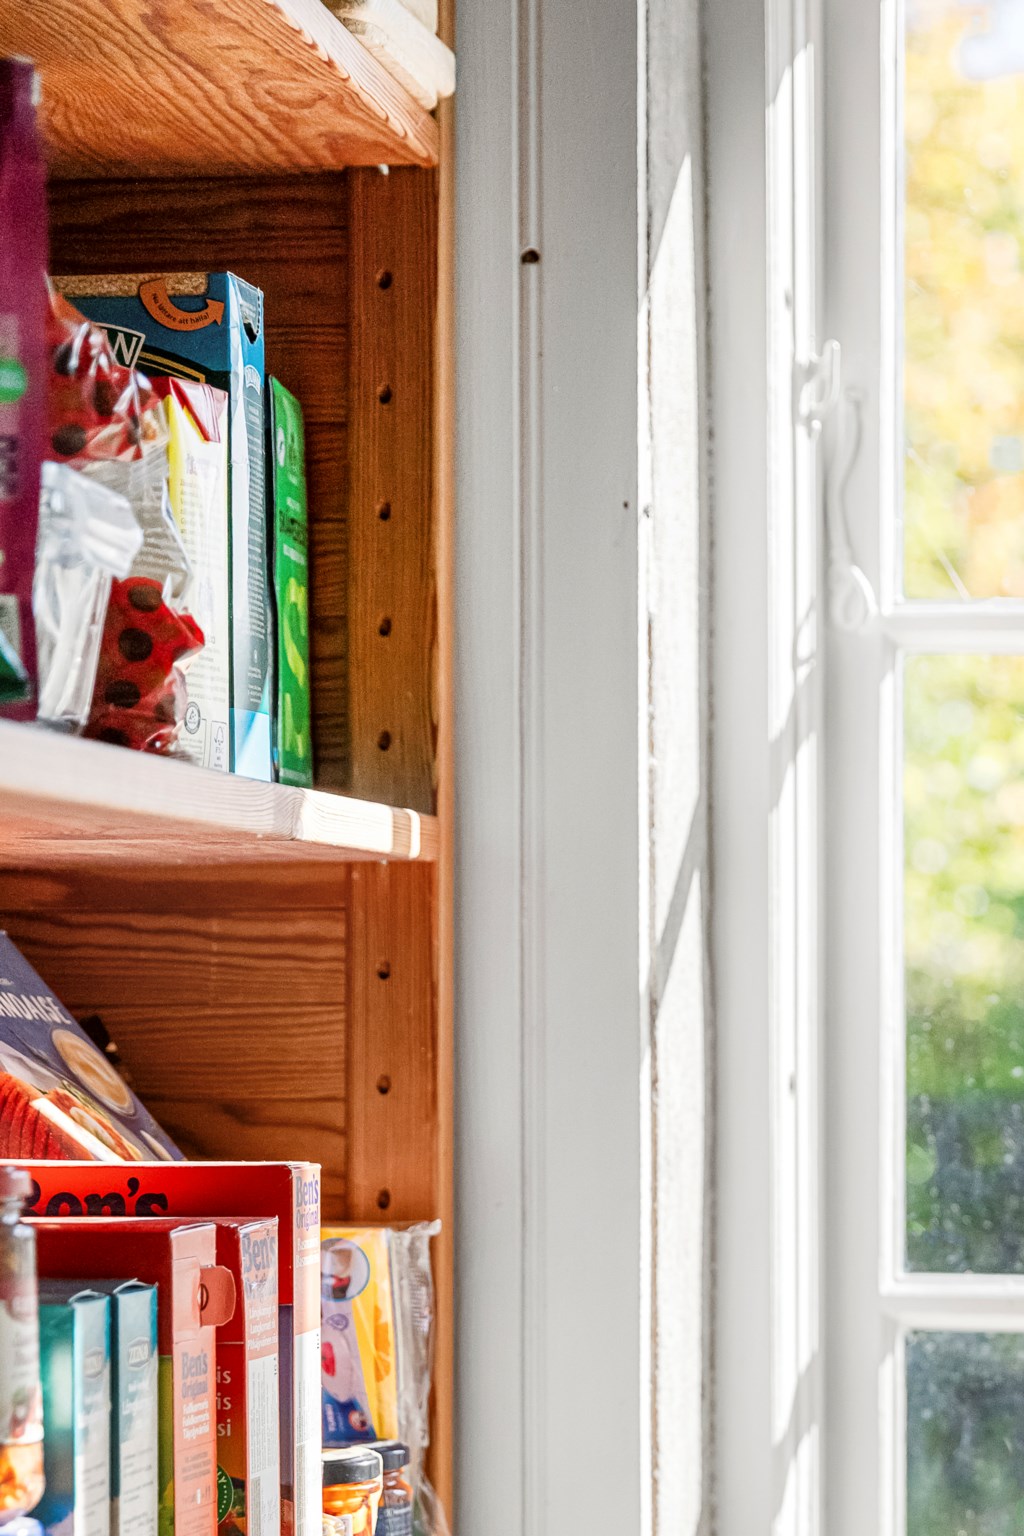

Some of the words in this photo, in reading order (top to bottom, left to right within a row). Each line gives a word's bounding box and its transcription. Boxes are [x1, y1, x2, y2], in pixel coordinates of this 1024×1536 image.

[178, 316, 189, 325] att
[295, 1173, 319, 1208] Ben's
[182, 1348, 208, 1380] Ben's
